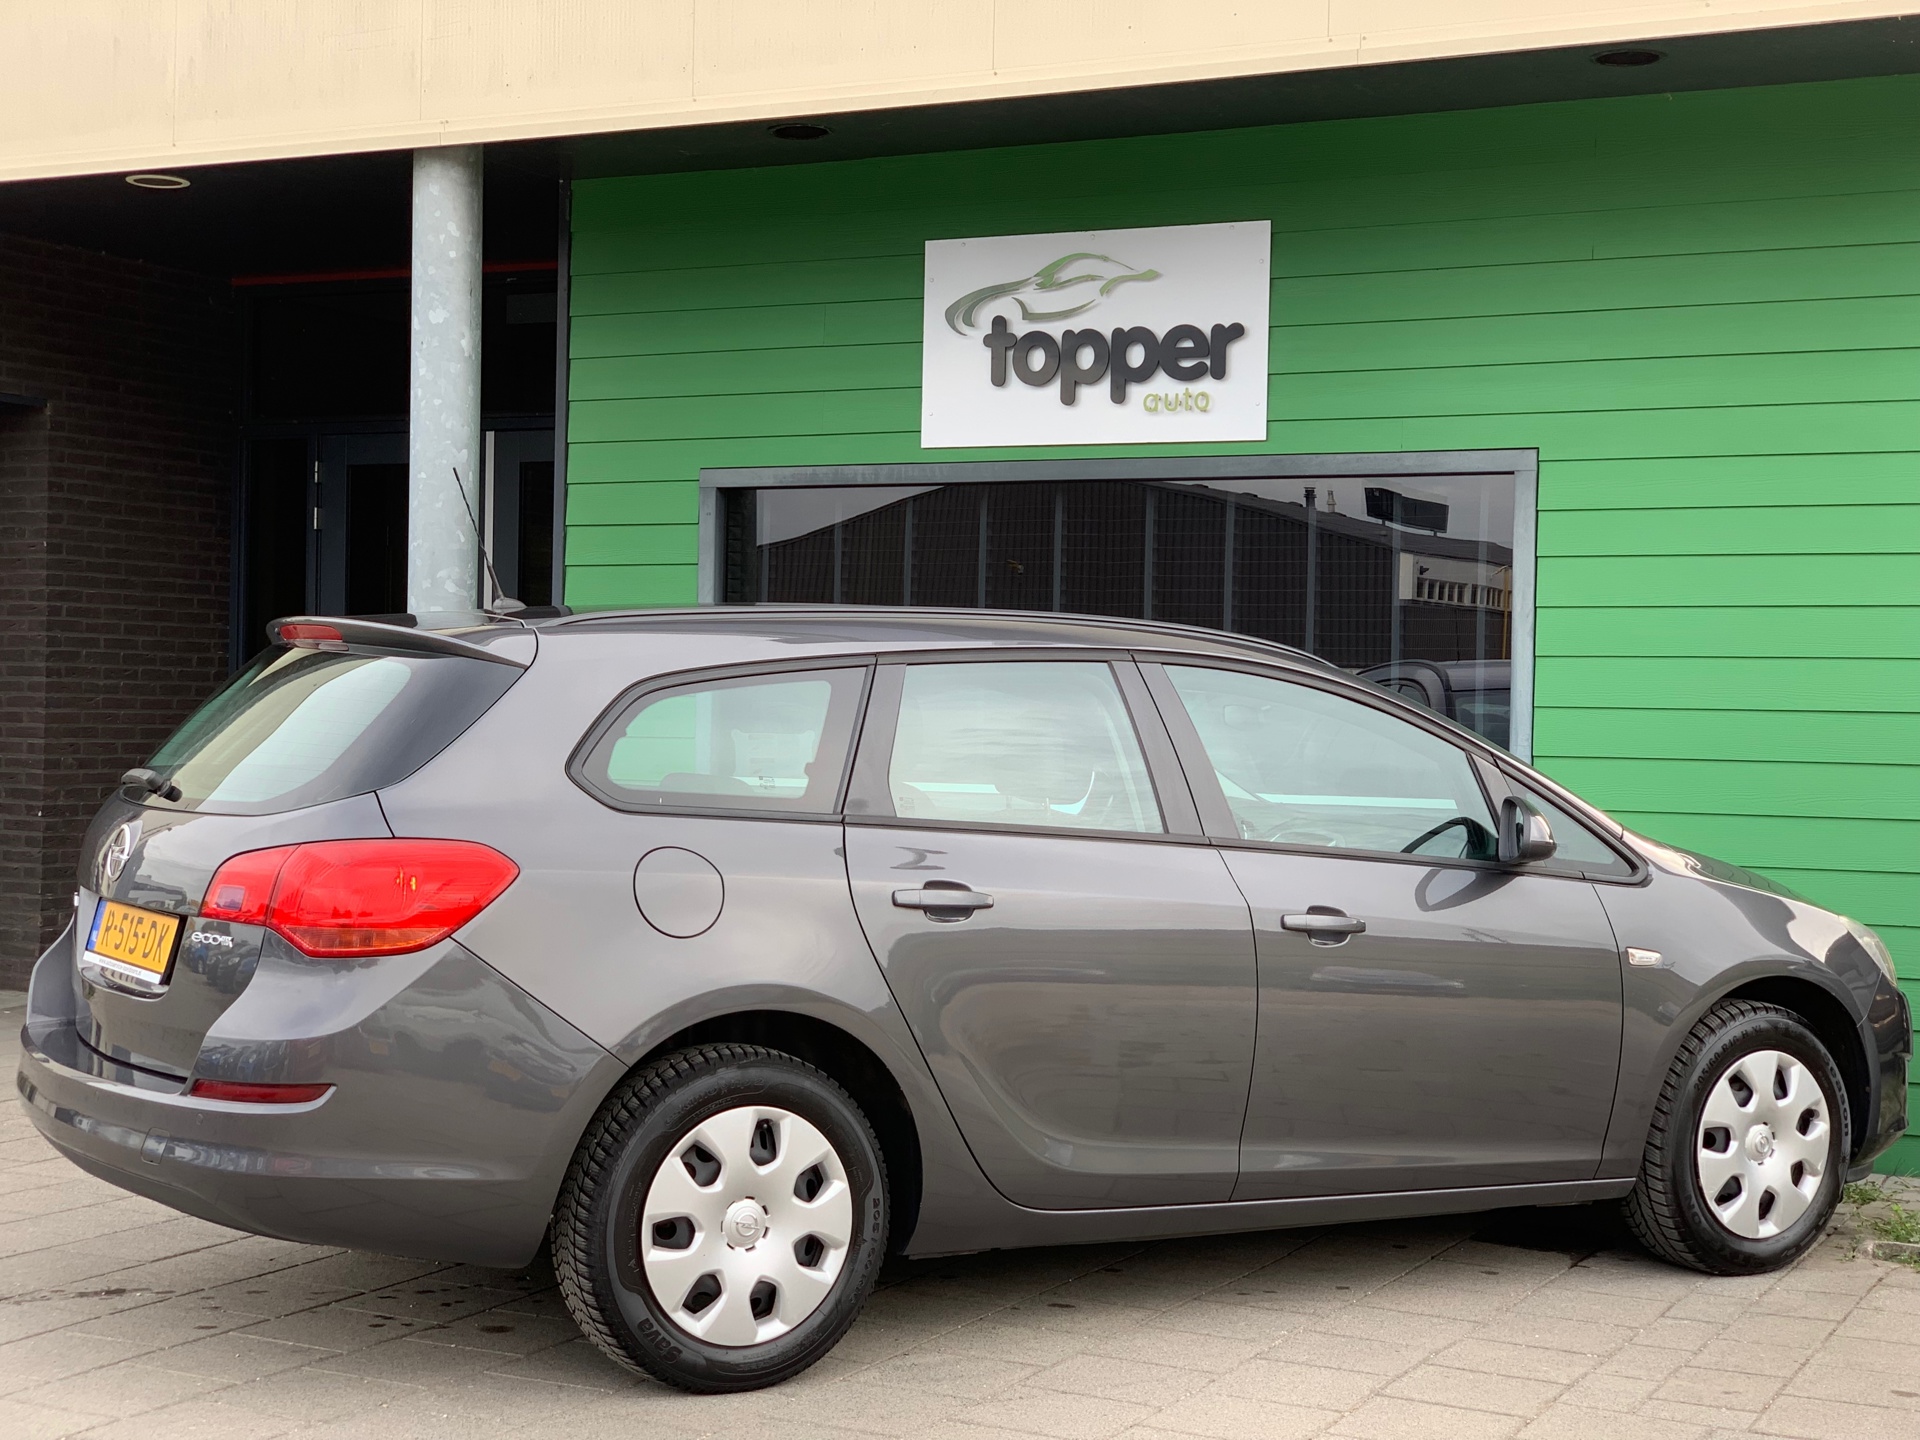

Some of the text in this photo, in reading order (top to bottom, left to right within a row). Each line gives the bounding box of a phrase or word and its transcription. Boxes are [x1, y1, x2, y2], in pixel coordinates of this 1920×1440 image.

[983, 314, 1245, 406] topper
[1143, 387, 1210, 412] auto
[101, 909, 170, 963] R-515-DK
[636, 1317, 684, 1364] Sava
